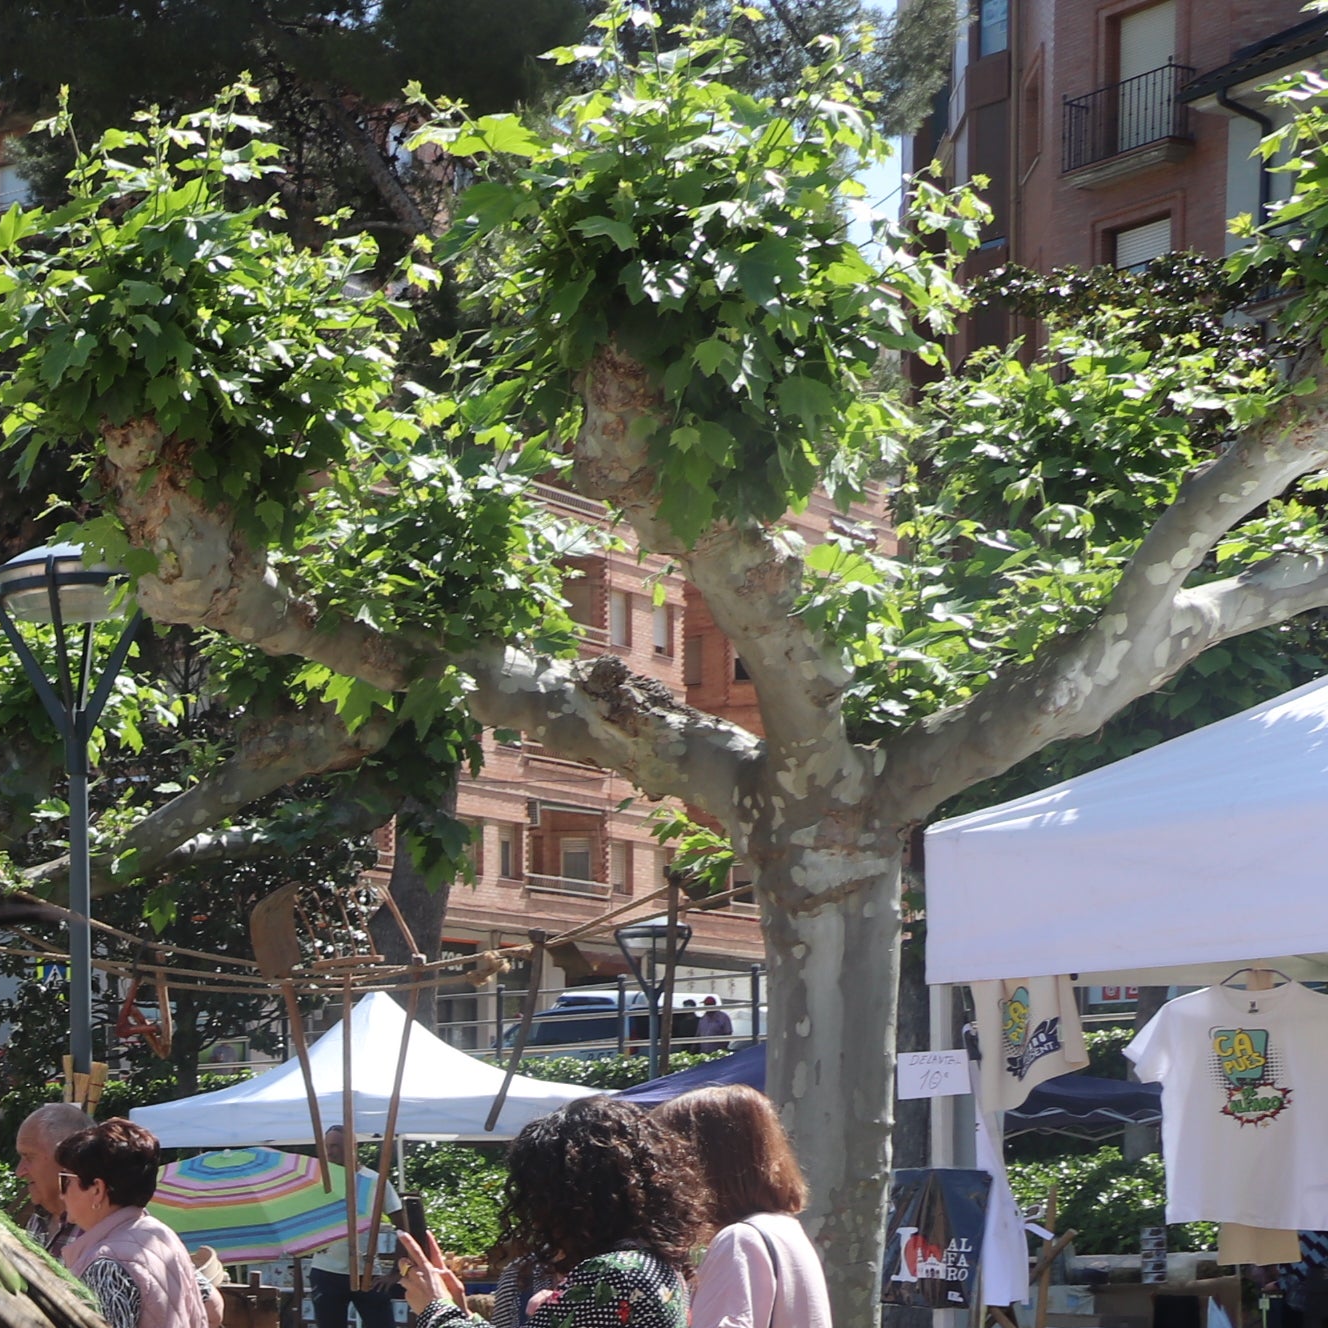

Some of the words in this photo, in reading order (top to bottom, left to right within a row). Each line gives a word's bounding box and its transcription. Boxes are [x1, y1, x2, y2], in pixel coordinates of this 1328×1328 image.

[1213, 1028, 1255, 1057] CÁ
[1224, 1052, 1267, 1074] PUES
[947, 1237, 973, 1252] AL
[946, 1252, 970, 1267] FA
[946, 1267, 969, 1281] RO
